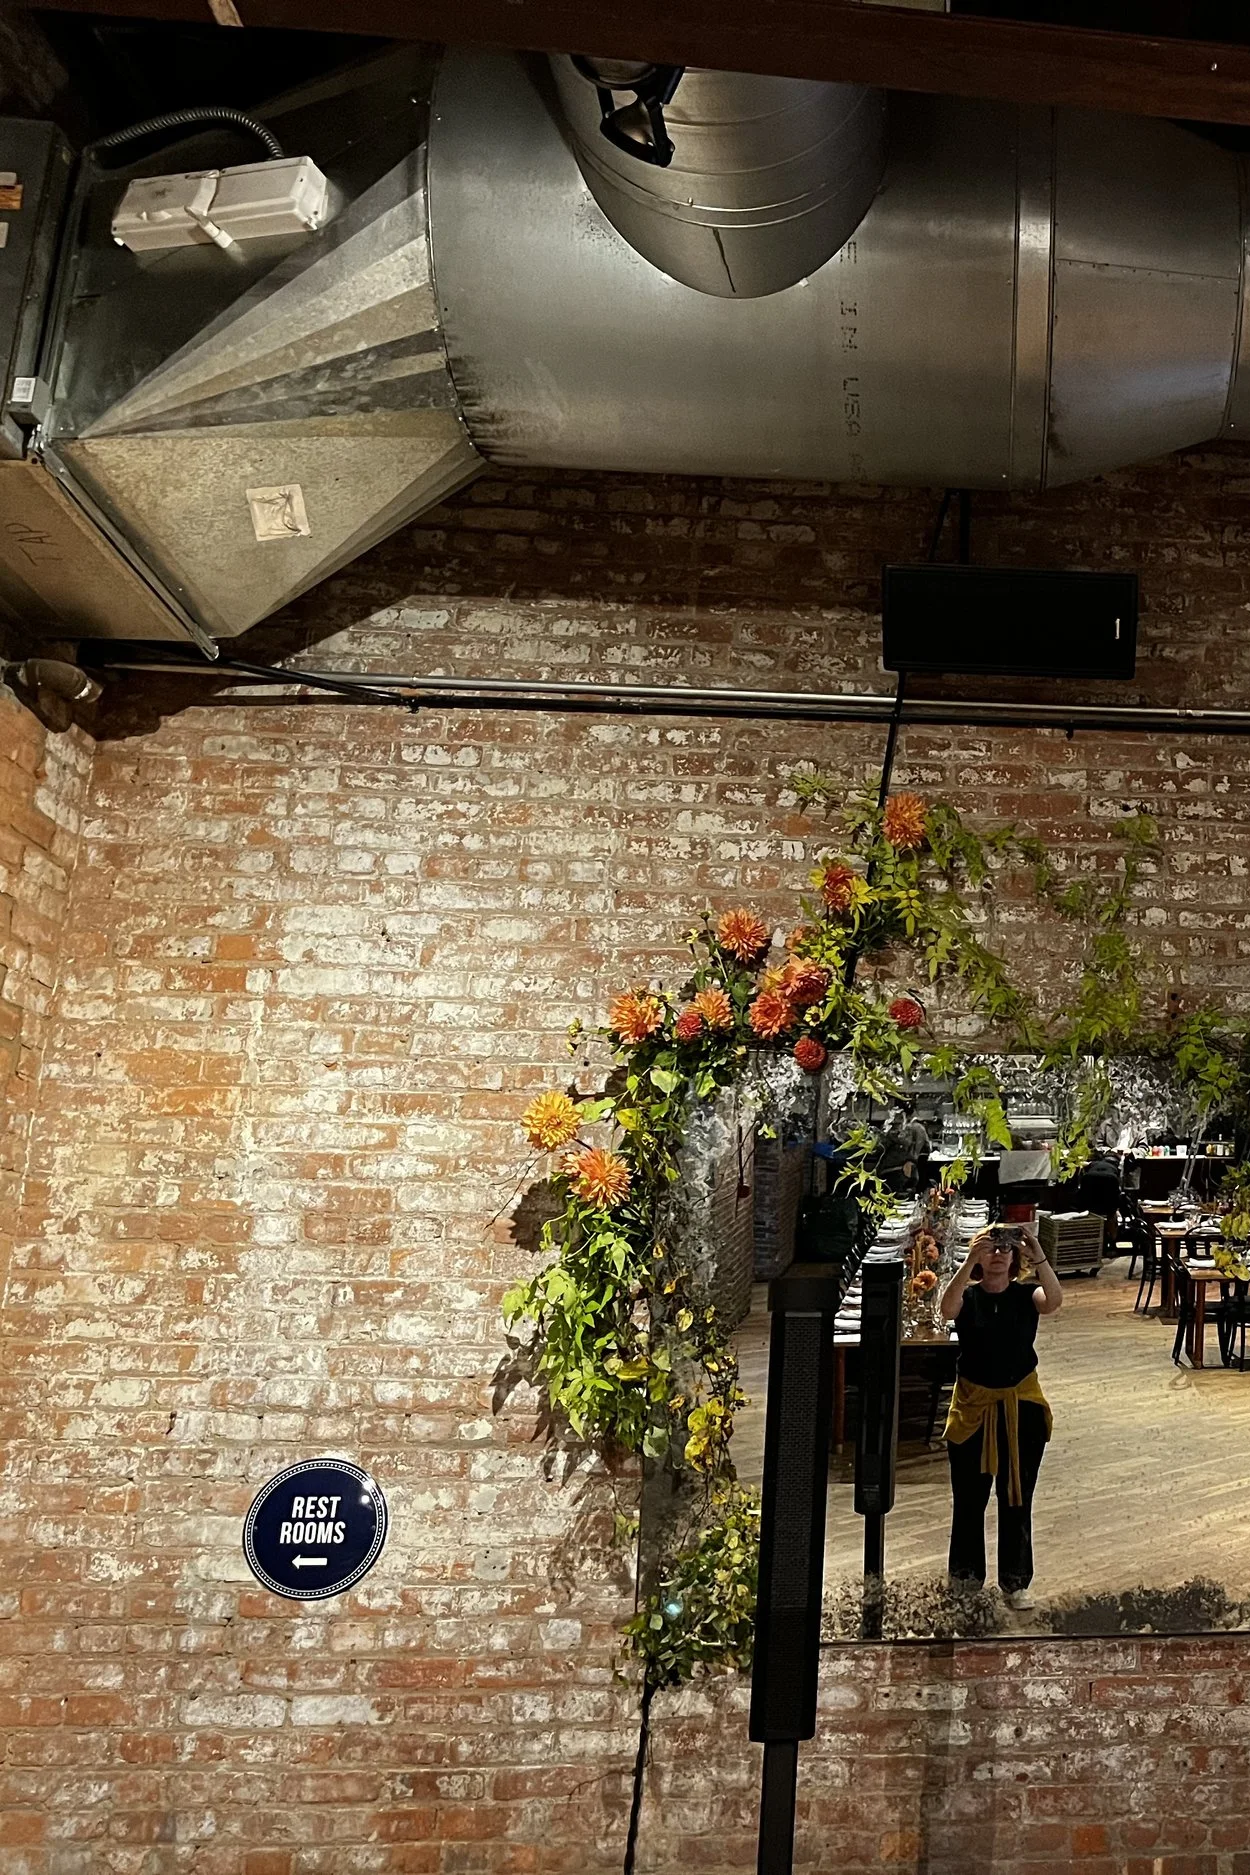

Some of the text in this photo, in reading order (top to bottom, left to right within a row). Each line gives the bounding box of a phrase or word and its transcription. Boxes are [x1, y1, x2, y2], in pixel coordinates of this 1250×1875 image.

[842, 377, 862, 438] USA
[291, 1496, 342, 1519] REST
[279, 1521, 347, 1544] ROOMS
